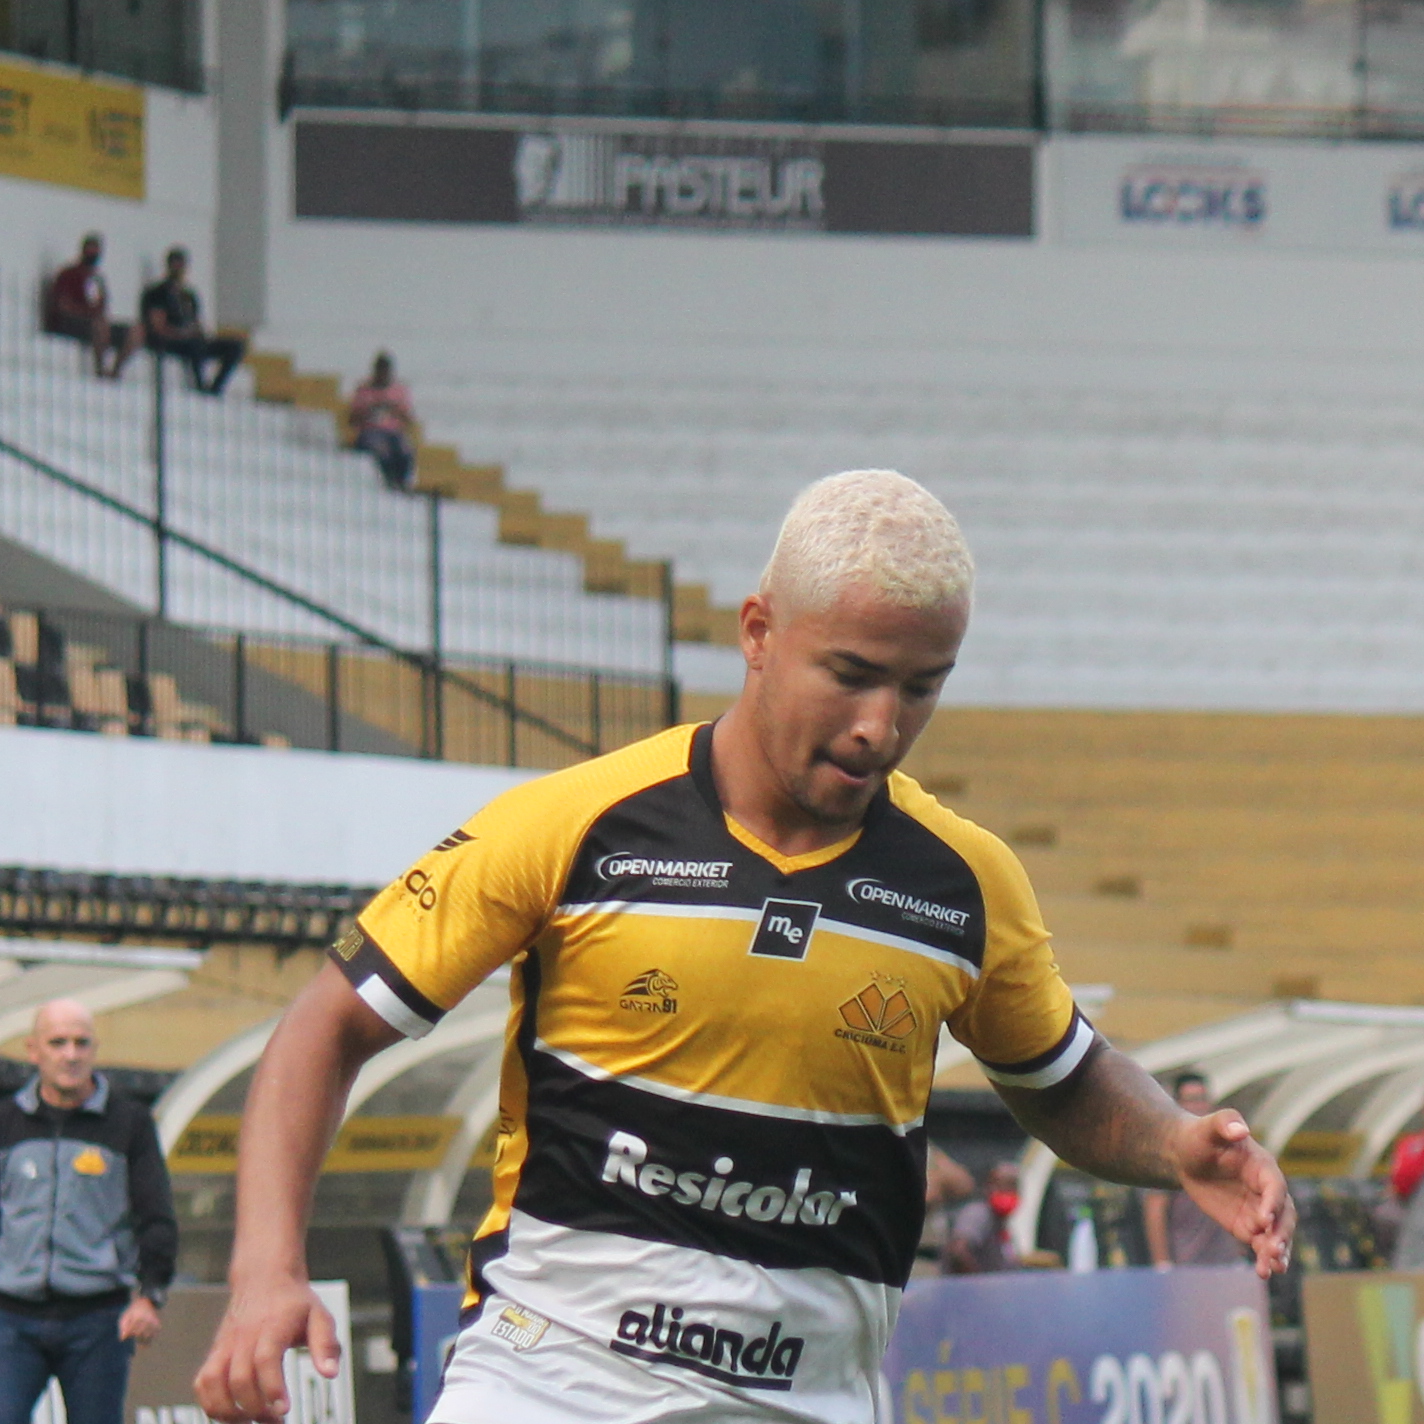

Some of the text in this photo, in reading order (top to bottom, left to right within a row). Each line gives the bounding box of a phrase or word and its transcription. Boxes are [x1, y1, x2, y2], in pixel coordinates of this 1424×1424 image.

[692, 878, 729, 889] EXTERIOR
[602, 1130, 857, 1225] Resicolor
[492, 1320, 535, 1349] ESTADO
